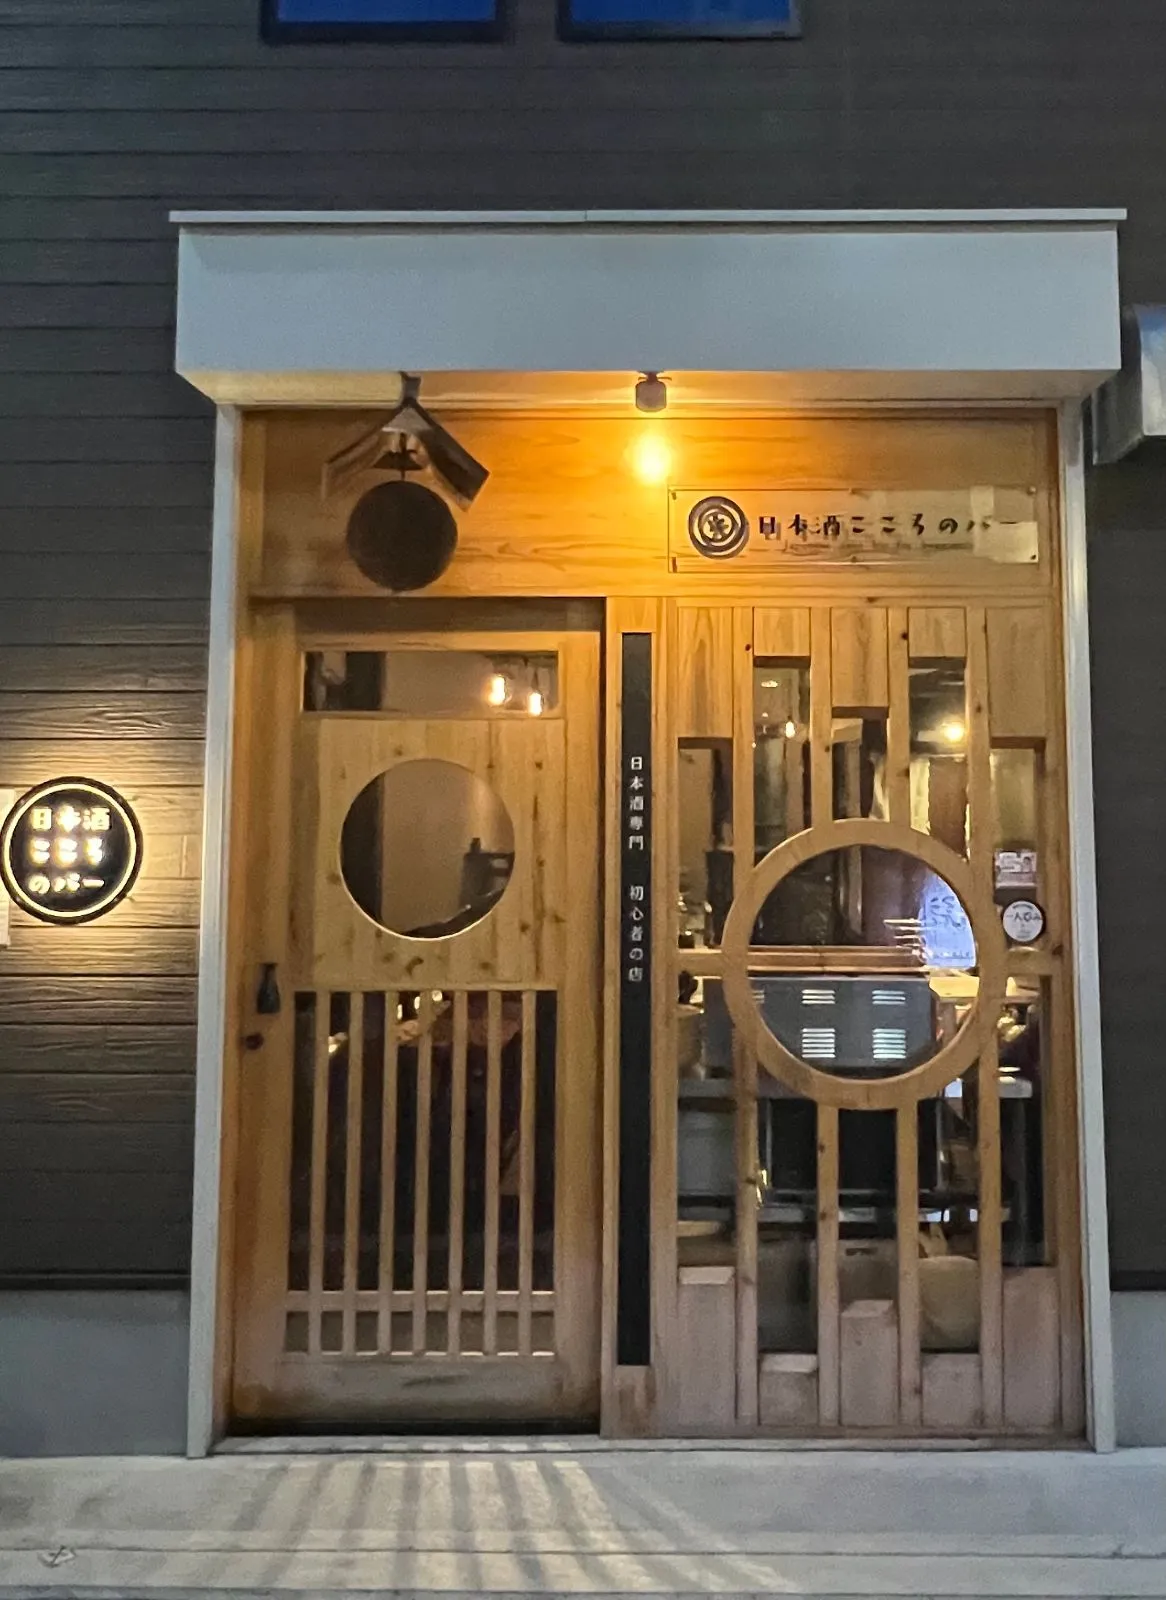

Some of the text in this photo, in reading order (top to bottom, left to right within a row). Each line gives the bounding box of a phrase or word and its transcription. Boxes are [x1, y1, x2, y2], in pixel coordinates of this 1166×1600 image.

[31, 804, 111, 832] 日本酒
[29, 838, 103, 866] こころ
[28, 872, 105, 895] のバー
[628, 756, 644, 983] 日本酒専門 初心者の店
